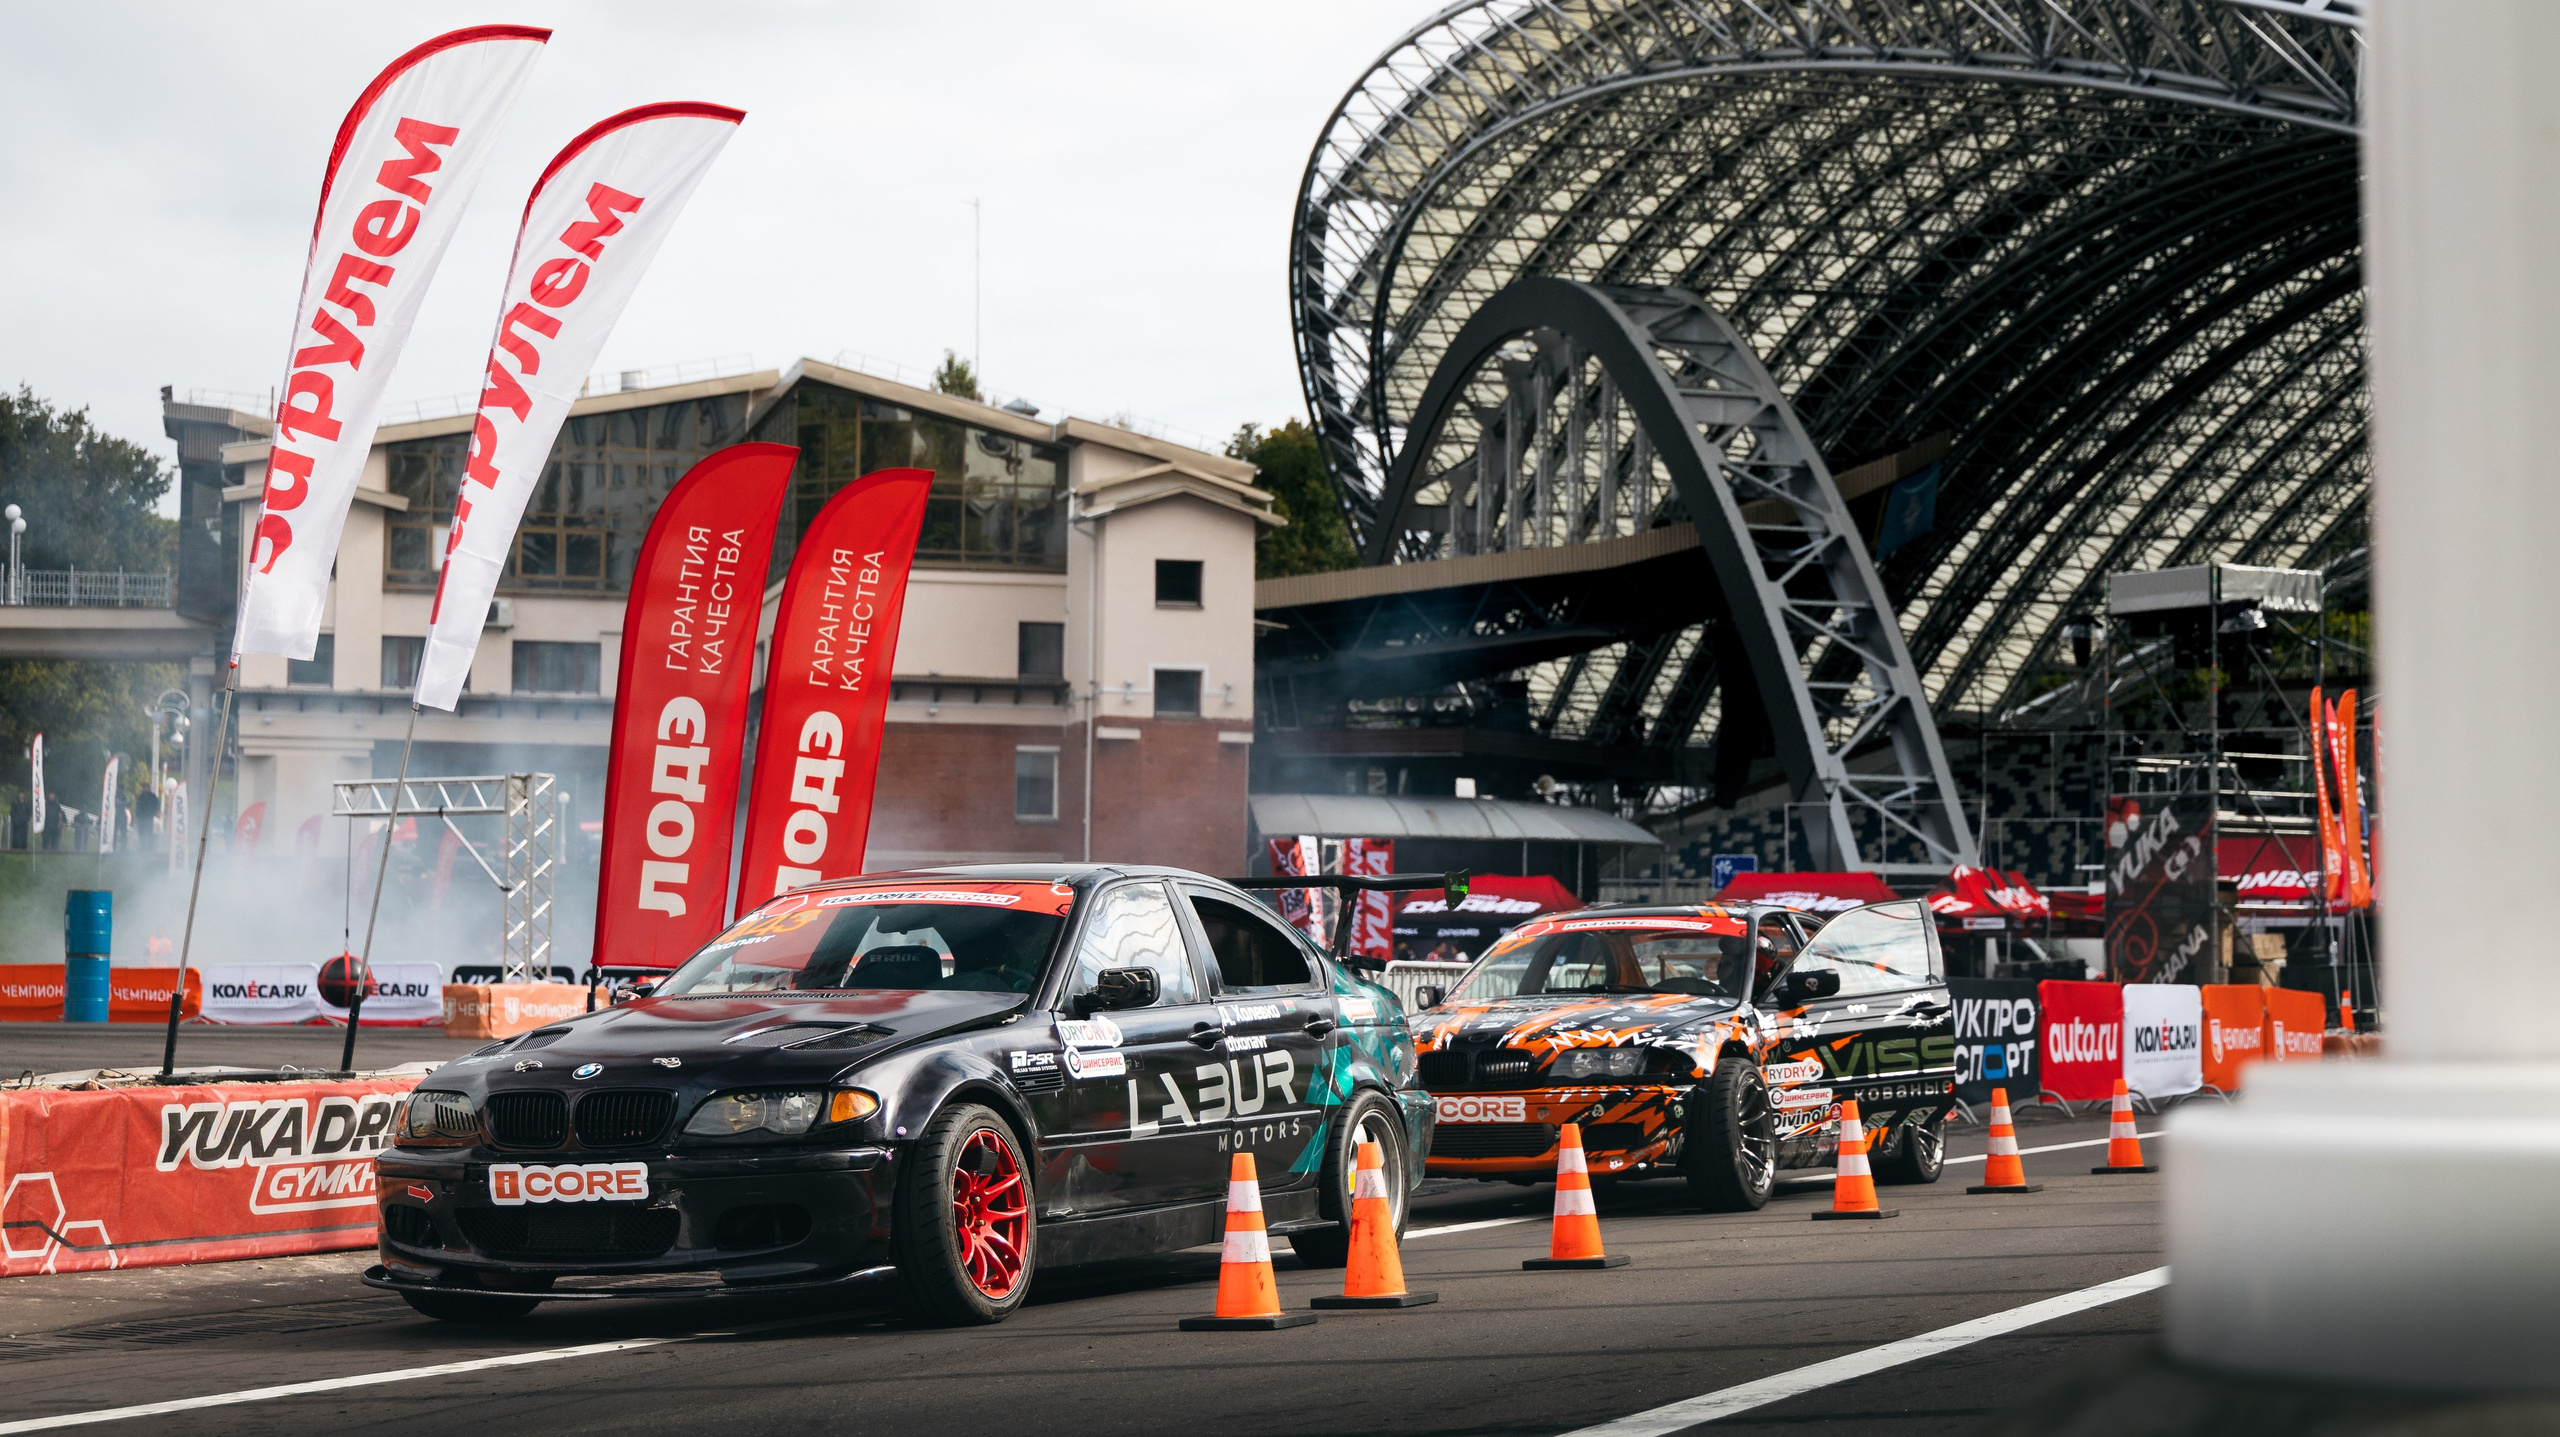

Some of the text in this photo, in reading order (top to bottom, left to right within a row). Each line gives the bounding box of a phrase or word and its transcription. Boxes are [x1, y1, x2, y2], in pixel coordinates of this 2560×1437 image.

[667, 525, 712, 671] ГАРАНТИЯ
[699, 528, 745, 675] КАЧЕСТВА
[809, 548, 854, 687] ГАРАНТИЯ
[839, 550, 885, 692] КАЧЕСТВА
[638, 696, 711, 918] ЛОДЭ
[2109, 805, 2181, 896] YUKA
[867, 892, 924, 901] DRIVE
[1364, 851, 1389, 949] YUA
[114, 988, 190, 1002] ЧЕМПИОНТ
[1060, 1024, 1107, 1041] DRYDRY
[2049, 1016, 2119, 1064] auto.ru
[1027, 1052, 1055, 1066] PSR
[1082, 1057, 1123, 1069] ШИНСЕРВИС
[1954, 1039, 2035, 1085] СПОРТ
[1128, 1049, 1297, 1139] LABUR
[1439, 1101, 1522, 1118] CORE
[1784, 1091, 1830, 1102] ШИНСЕРВИС
[1854, 1079, 1954, 1104] кованые
[161, 1105, 303, 1164] YUKA
[1218, 1117, 1300, 1153] MOTORS
